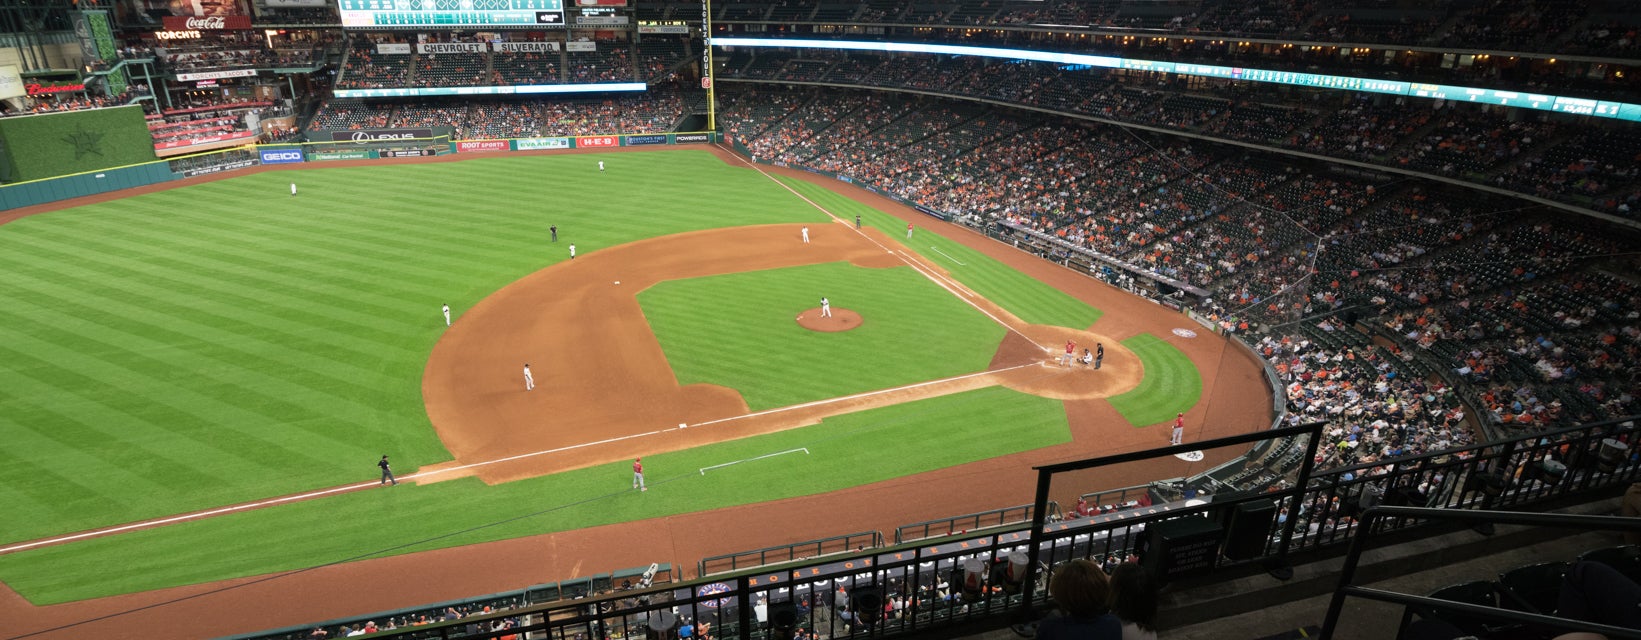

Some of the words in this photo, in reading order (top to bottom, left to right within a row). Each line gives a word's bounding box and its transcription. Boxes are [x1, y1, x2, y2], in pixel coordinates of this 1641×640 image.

[155, 31, 201, 40] TORCHYS
[423, 44, 481, 53] CHEVROLET
[501, 43, 553, 52] SILVERADO
[371, 133, 415, 141] LEXUS
[583, 137, 612, 145] H-E-B
[263, 152, 300, 161] GEICO
[845, 559, 871, 568] OF
